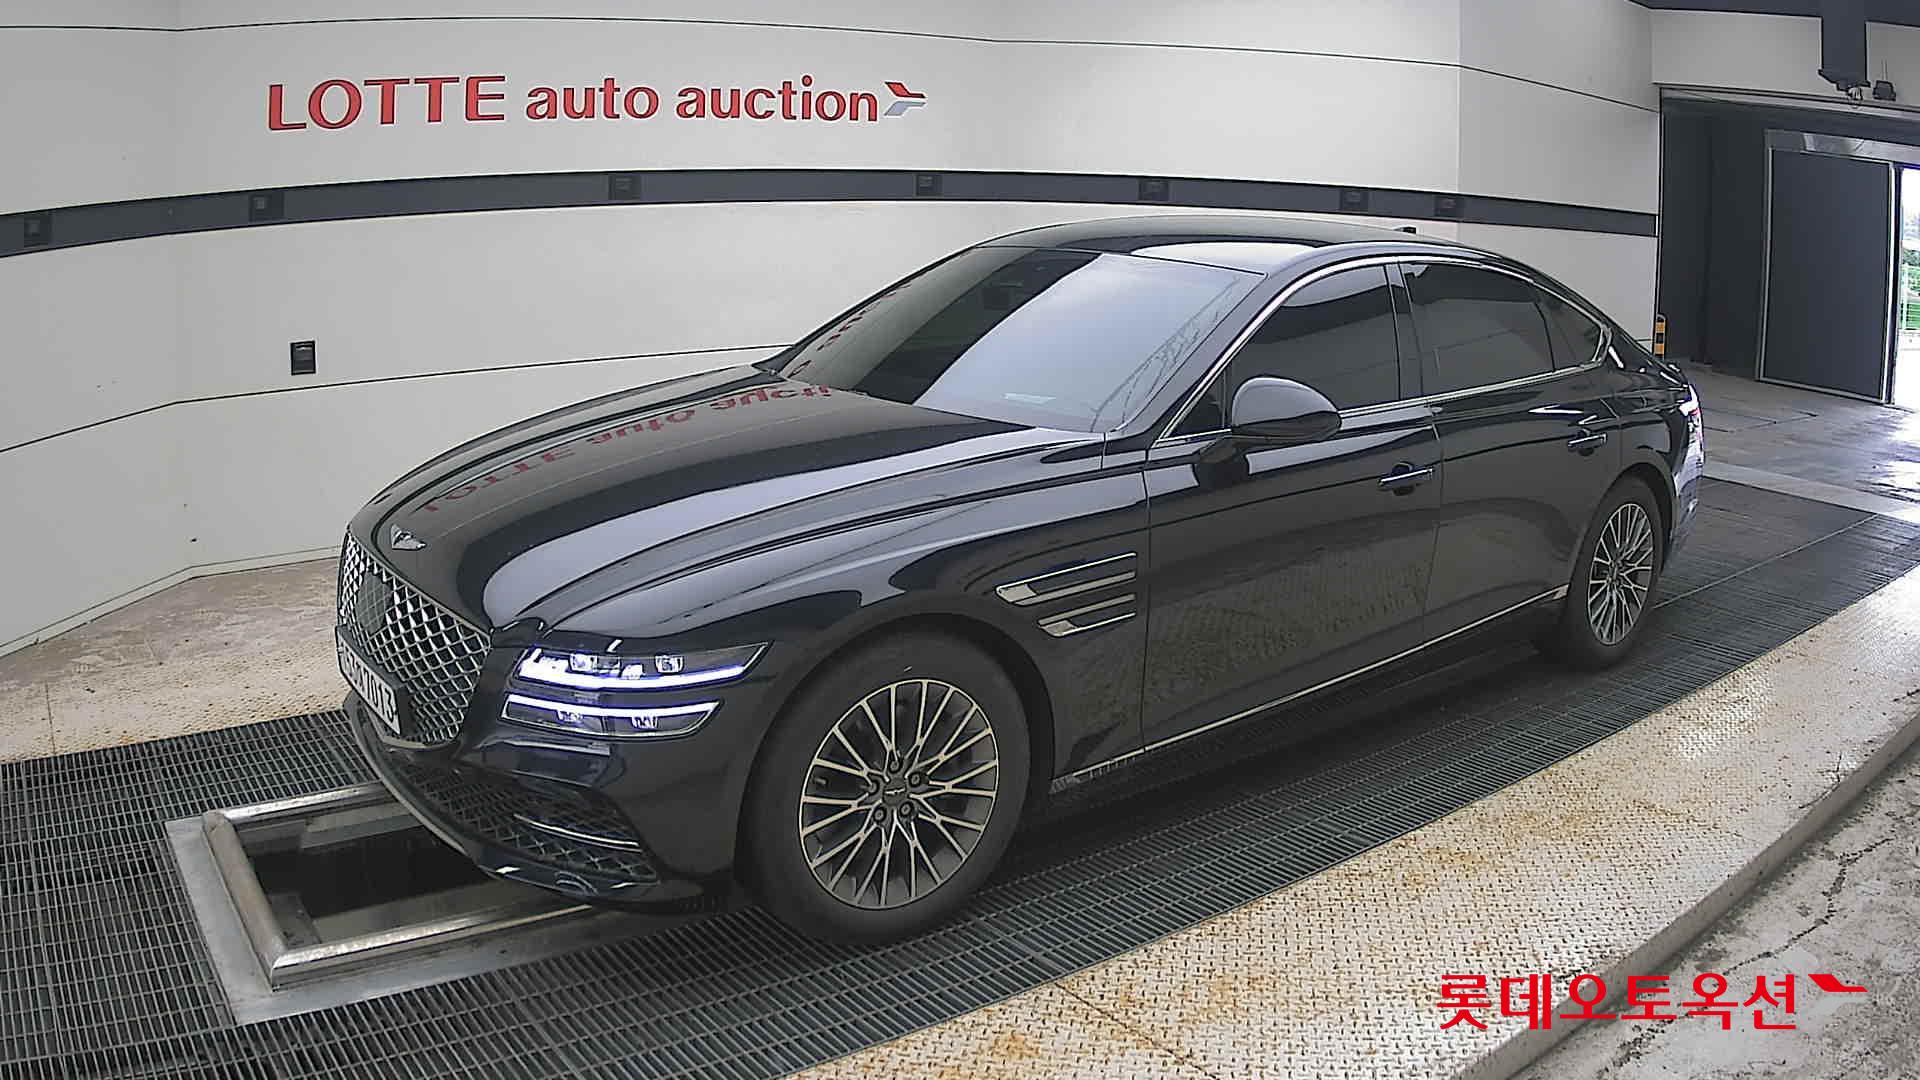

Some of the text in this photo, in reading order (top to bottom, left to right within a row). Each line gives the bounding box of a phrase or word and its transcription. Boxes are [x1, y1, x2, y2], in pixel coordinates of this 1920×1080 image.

[268, 75, 879, 131] LOTTE auto auction
